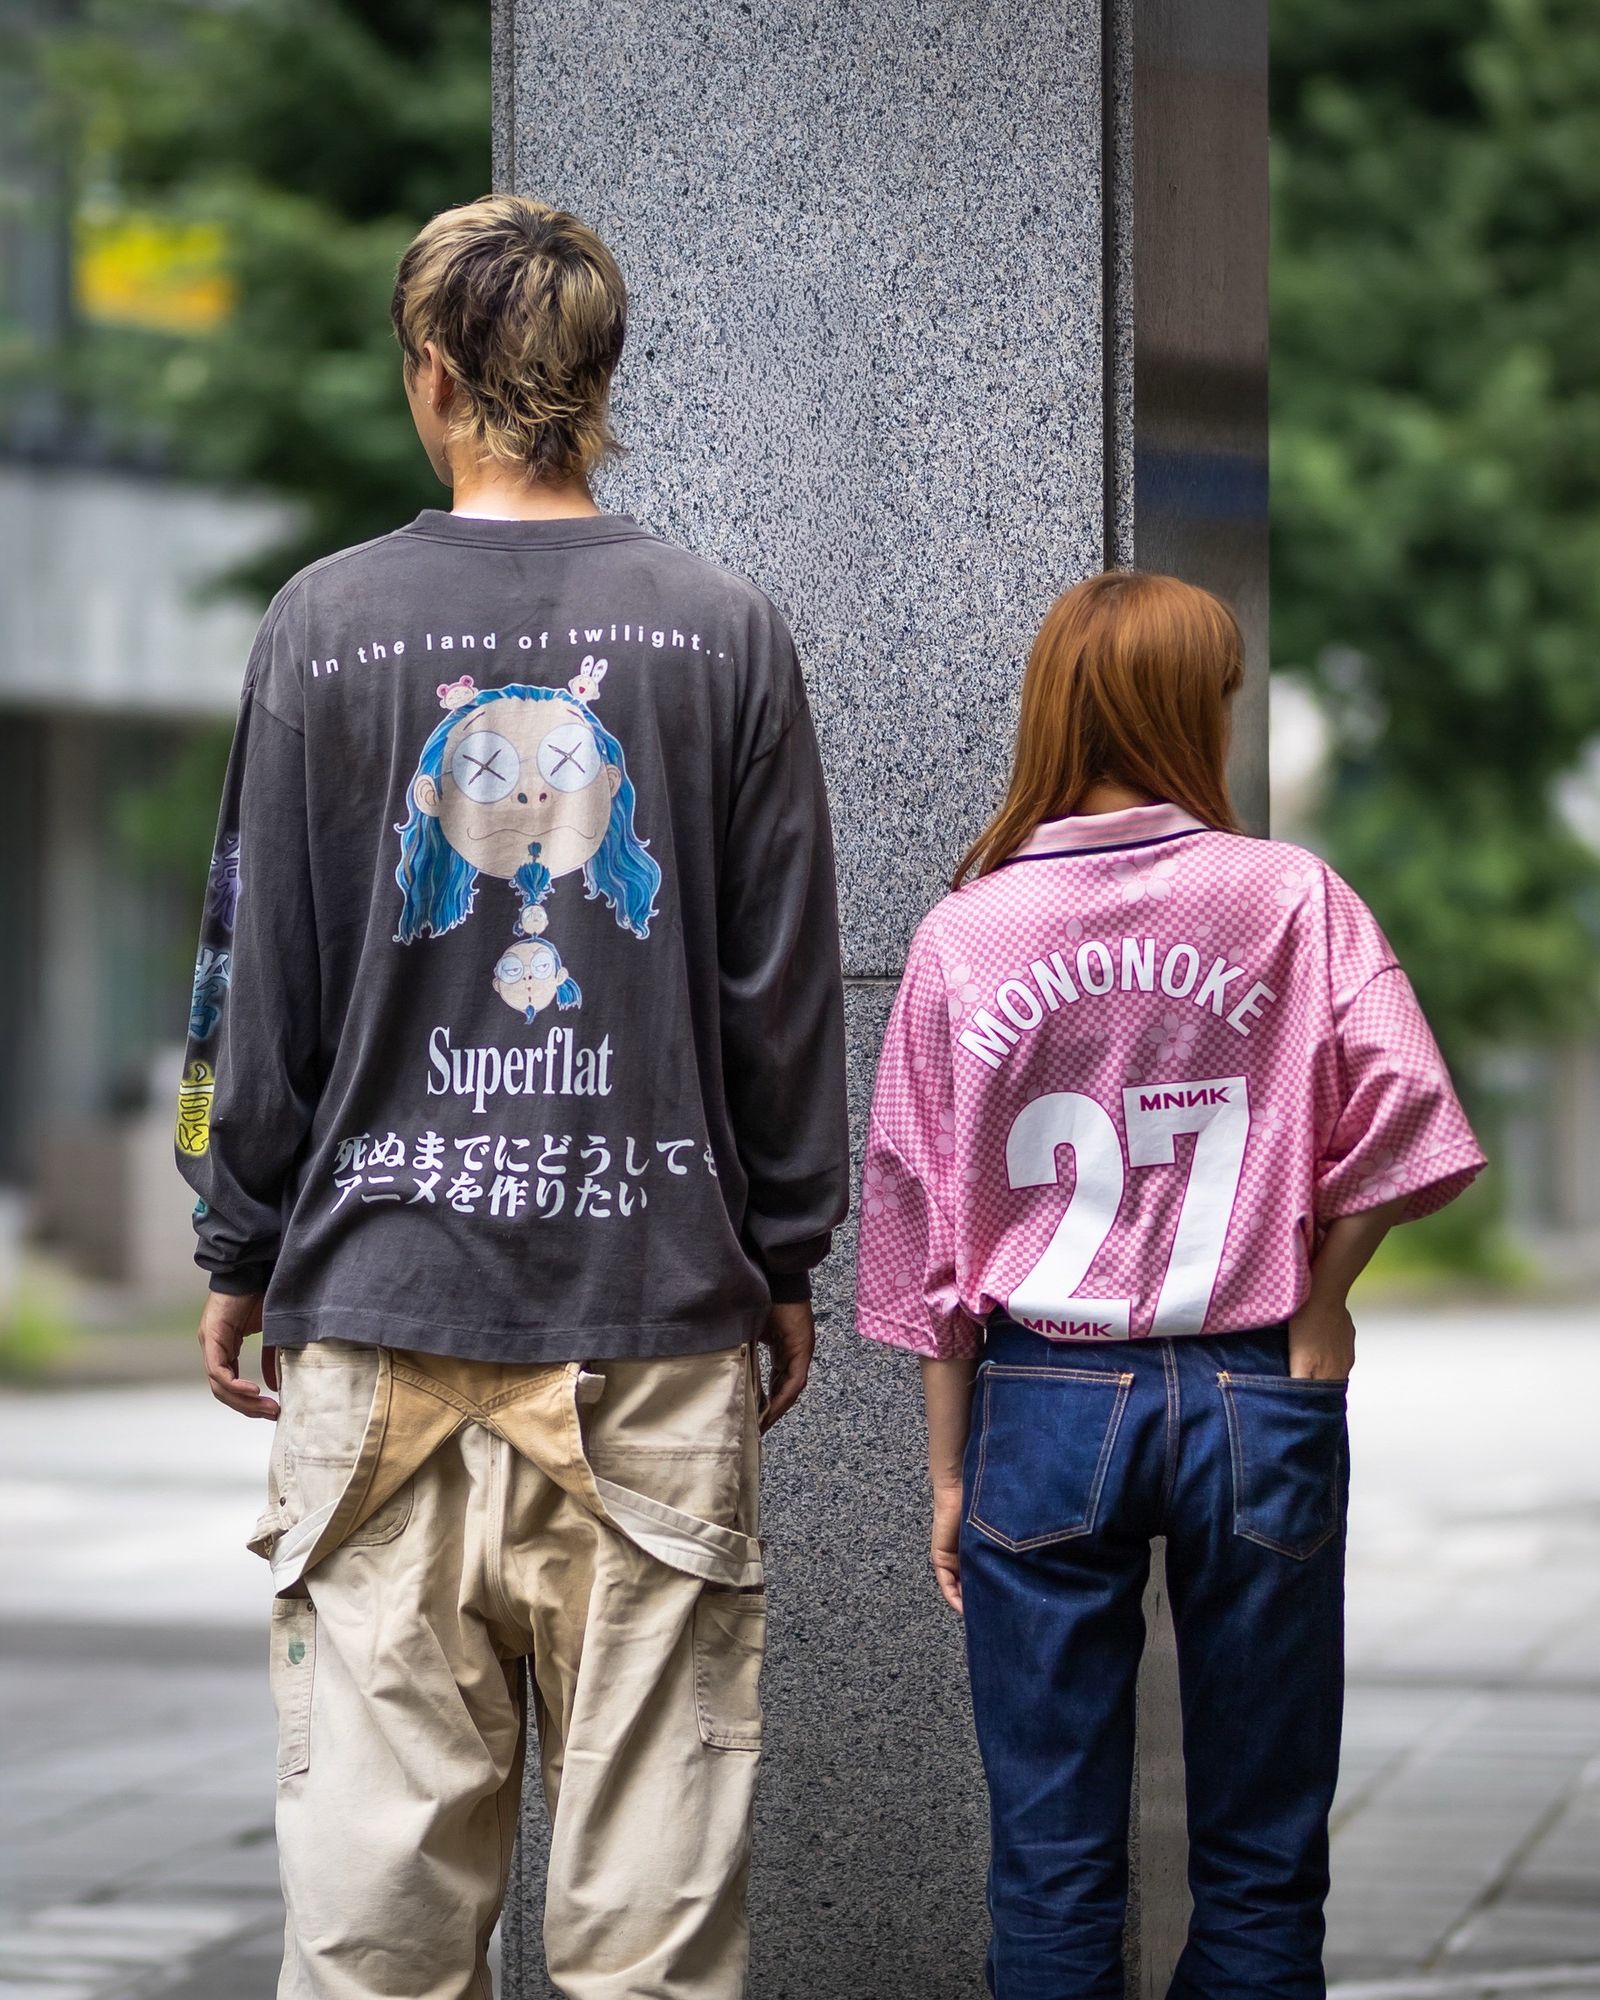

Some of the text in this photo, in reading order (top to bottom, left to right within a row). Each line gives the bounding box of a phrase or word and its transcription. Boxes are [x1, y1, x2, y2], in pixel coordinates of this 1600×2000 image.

[311, 658, 339, 678] In
[357, 640, 405, 664] the
[426, 632, 496, 651] land
[518, 631, 549, 650] of
[958, 937, 1277, 1070] MONONOKE
[426, 1026, 614, 1114] Superflat
[329, 1171, 648, 1219] アニメを作りたい
[1005, 1075, 1251, 1341] 27
